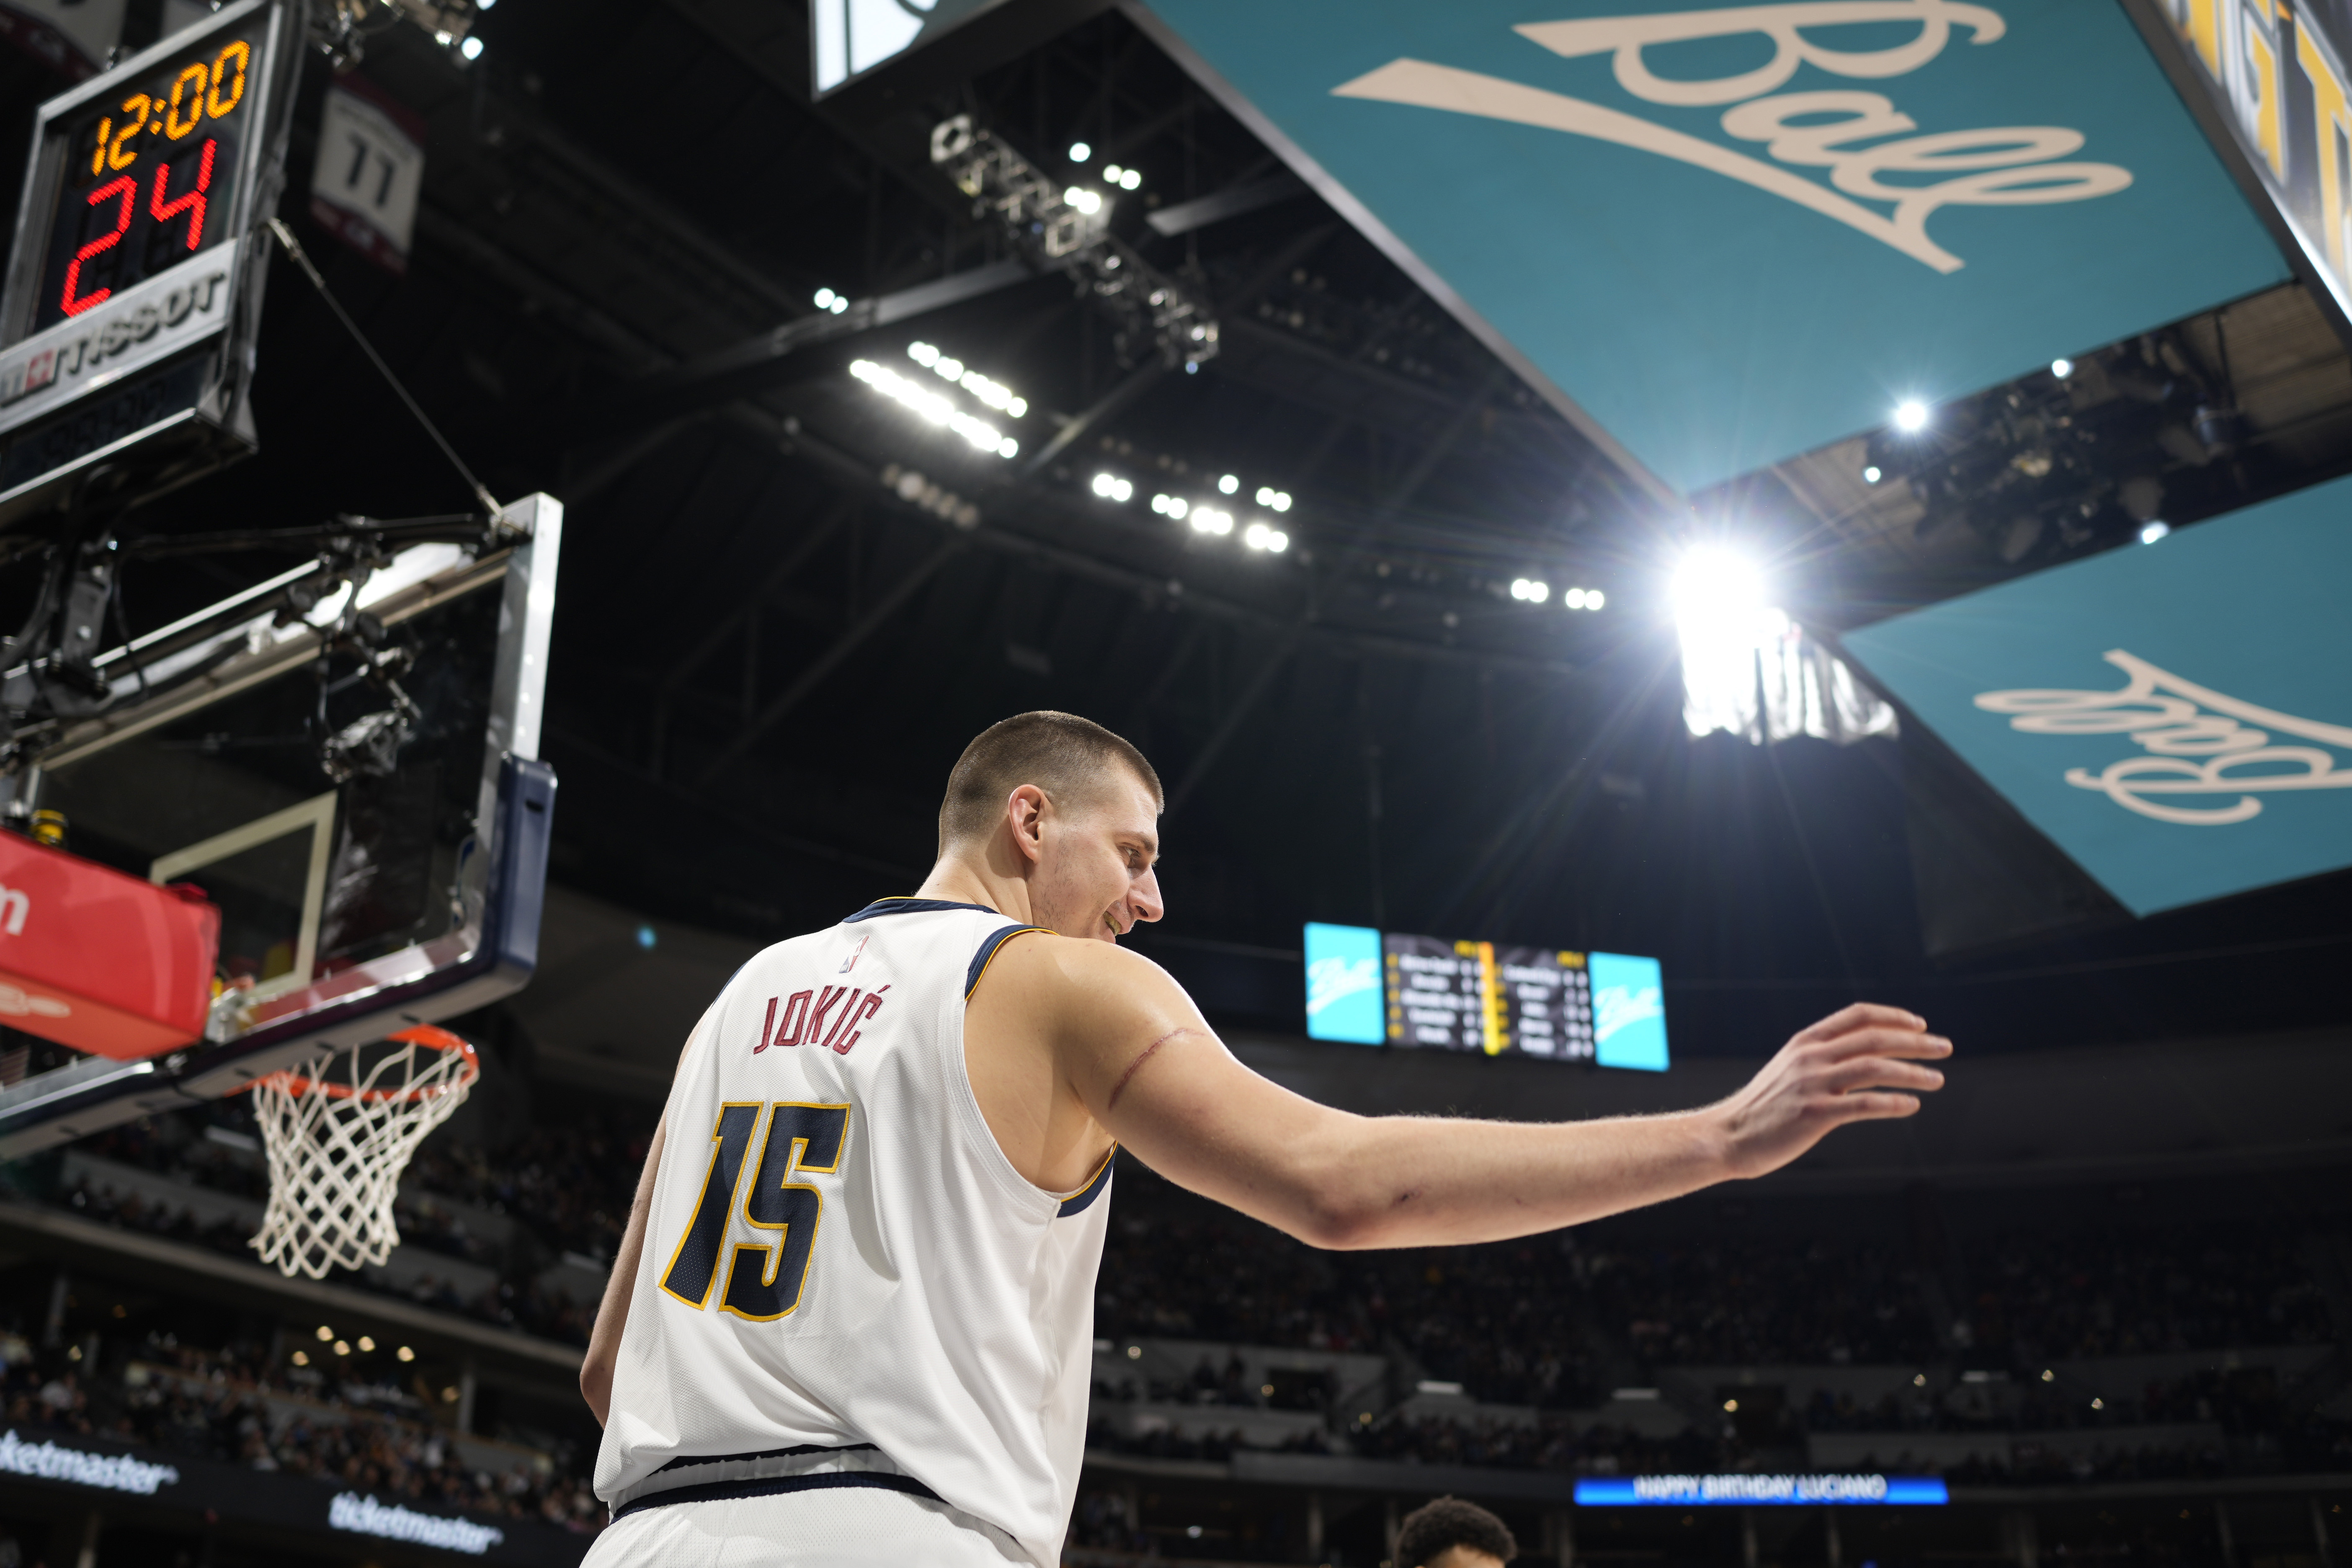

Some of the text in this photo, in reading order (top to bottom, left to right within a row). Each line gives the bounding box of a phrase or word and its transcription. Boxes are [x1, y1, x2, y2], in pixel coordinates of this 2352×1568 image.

[91, 40, 250, 176] 12:00
[1328, 0, 2134, 274] Ball
[60, 138, 217, 318] 24
[58, 269, 226, 374] TISSOT
[753, 984, 890, 1055] JOKIĆ
[658, 1101, 851, 1323] 15
[0, 1429, 166, 1496] ketmaster
[1633, 1473, 1888, 1500] HAPPY BIRTHDAY LUCIANO
[328, 1490, 490, 1555] ticketmaster
